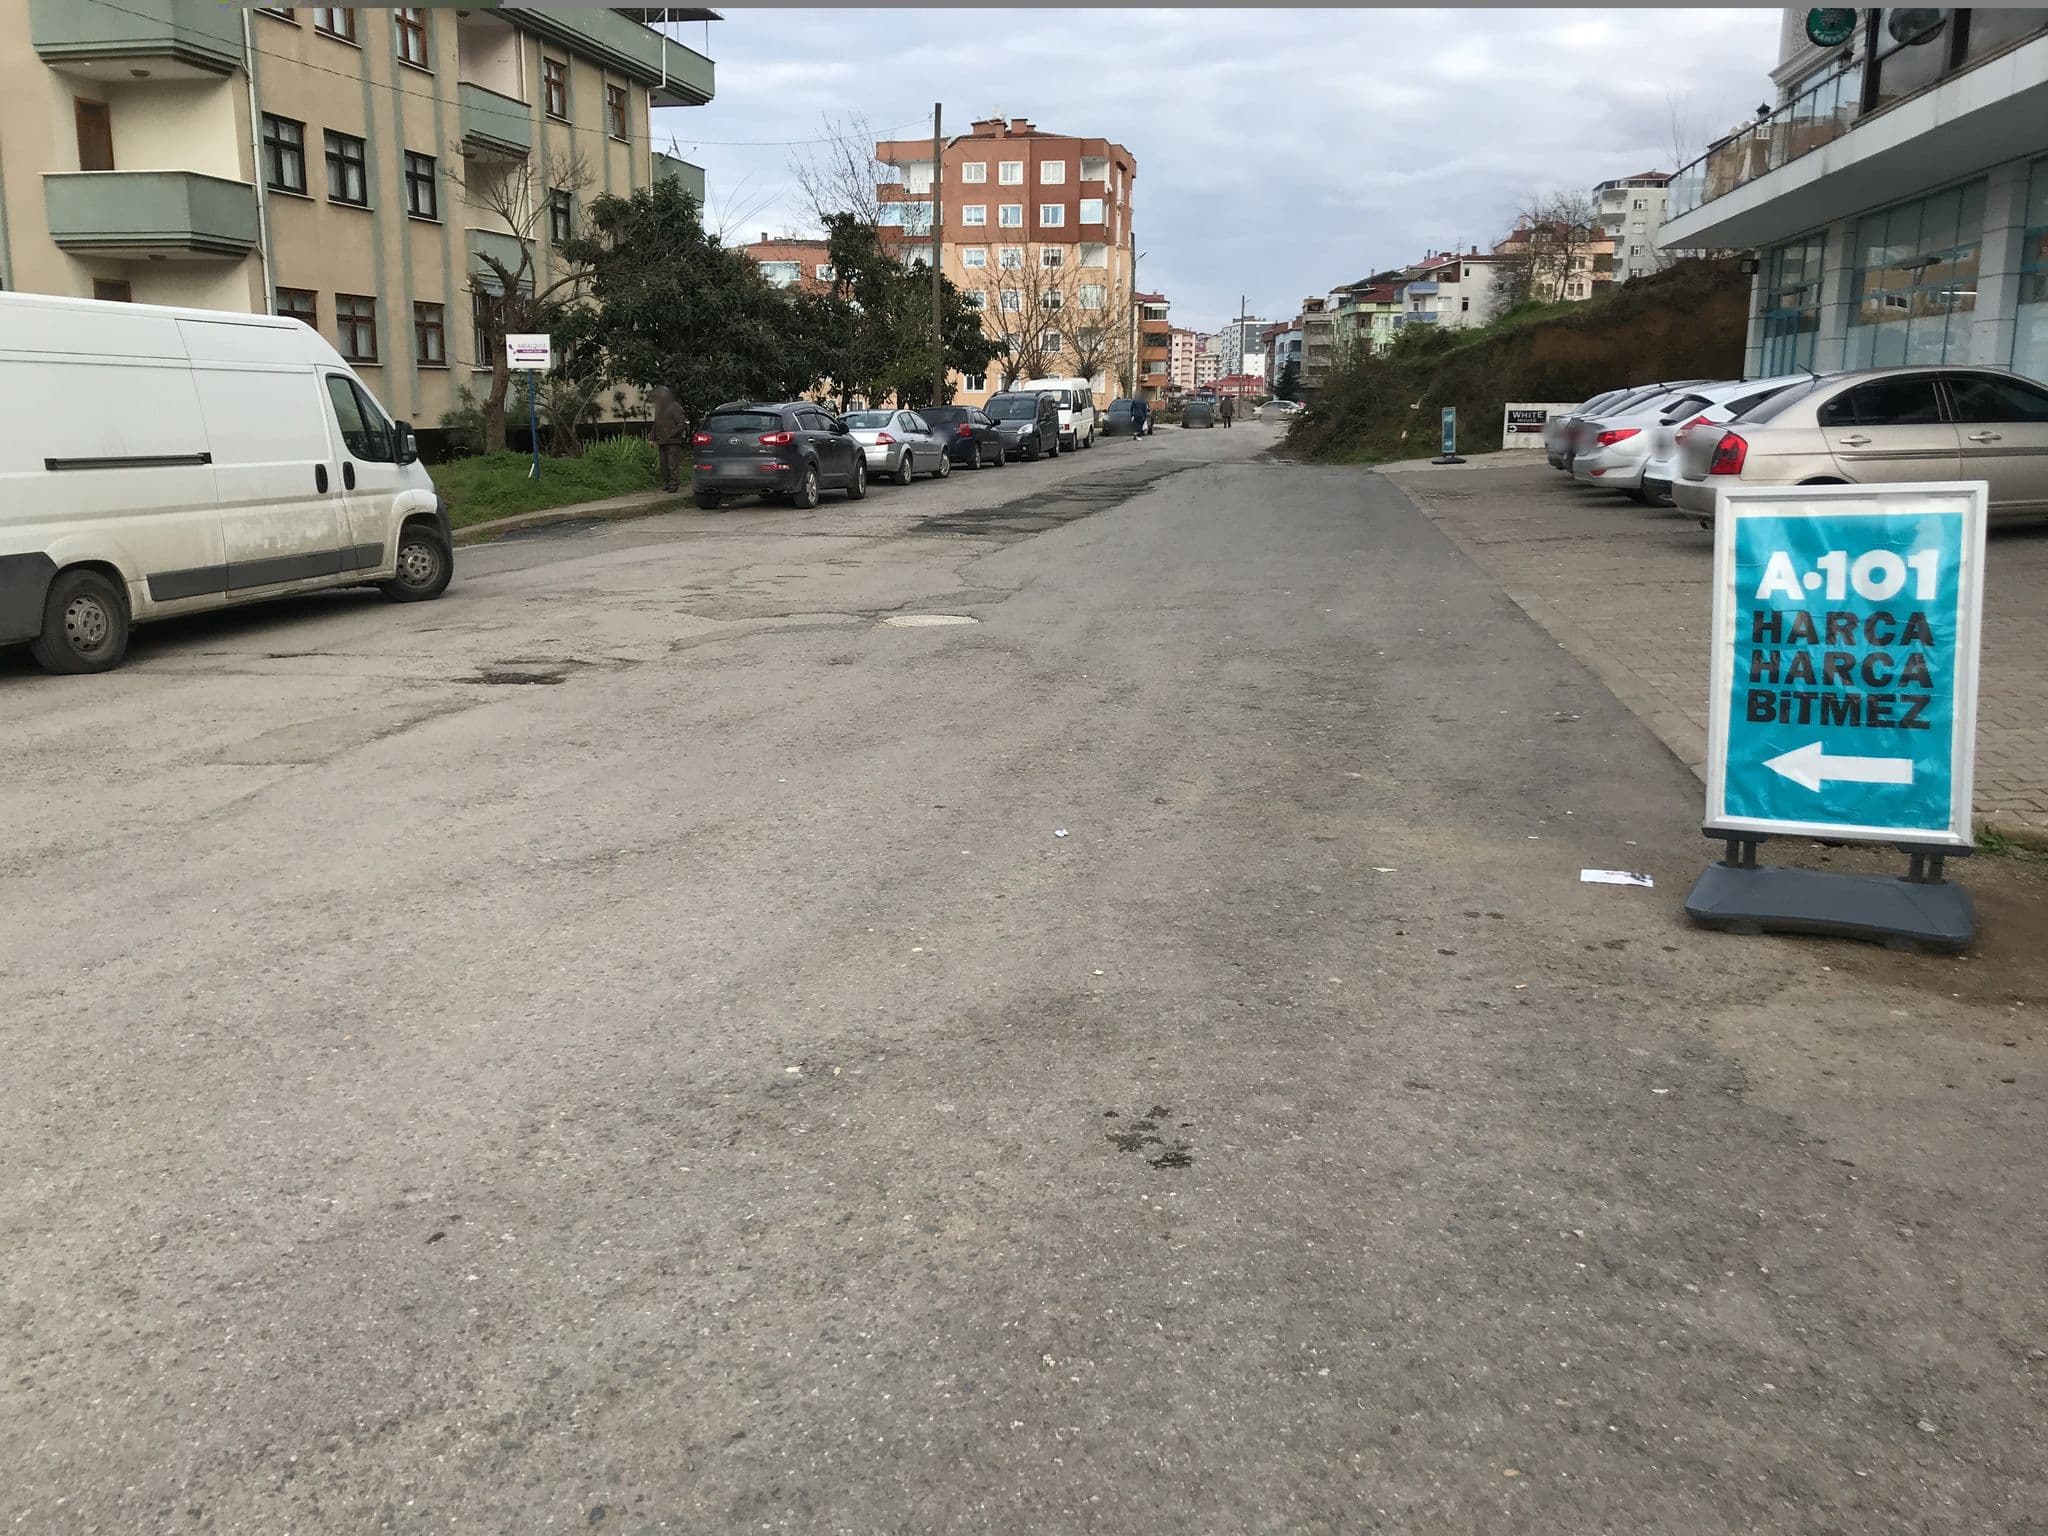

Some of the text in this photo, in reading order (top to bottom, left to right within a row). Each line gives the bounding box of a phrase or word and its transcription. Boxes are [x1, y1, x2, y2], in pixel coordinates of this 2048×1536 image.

[1512, 411, 1545, 419] WHITE
[1752, 610, 1935, 647] HARCA
[1749, 649, 1934, 689] HARCA
